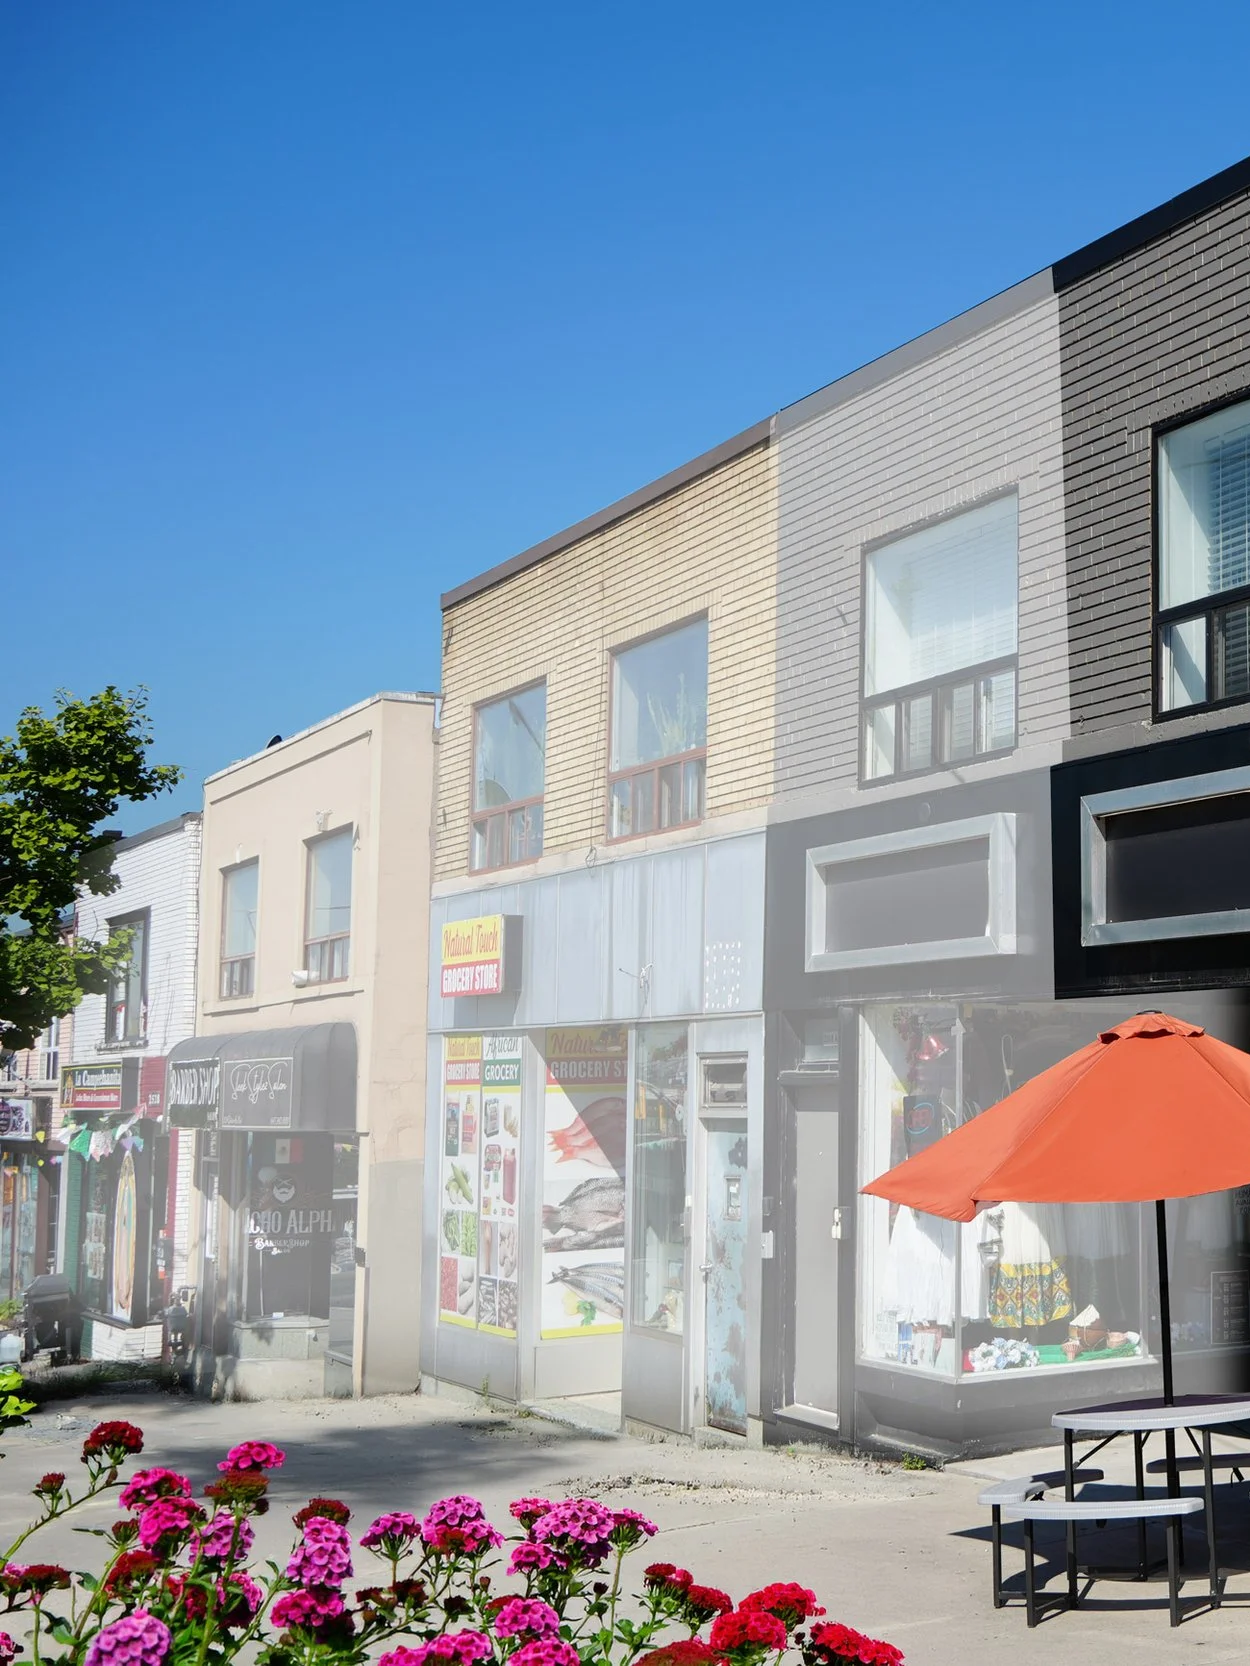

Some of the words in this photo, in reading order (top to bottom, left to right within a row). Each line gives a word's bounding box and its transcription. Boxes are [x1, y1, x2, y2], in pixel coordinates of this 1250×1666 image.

[444, 926, 473, 958] Natural
[475, 922, 498, 954] Touch
[443, 966, 474, 993] GROCERY
[475, 963, 498, 990] STORE
[486, 1032, 519, 1060] African
[551, 1032, 610, 1055] Natur
[447, 1063, 466, 1081] GROCERY
[466, 1062, 480, 1080] STORE
[485, 1064, 519, 1081] GROCERY
[550, 1060, 610, 1080] GROCERY
[169, 1068, 199, 1105] BARBER
[198, 1066, 219, 1105] SHOP
